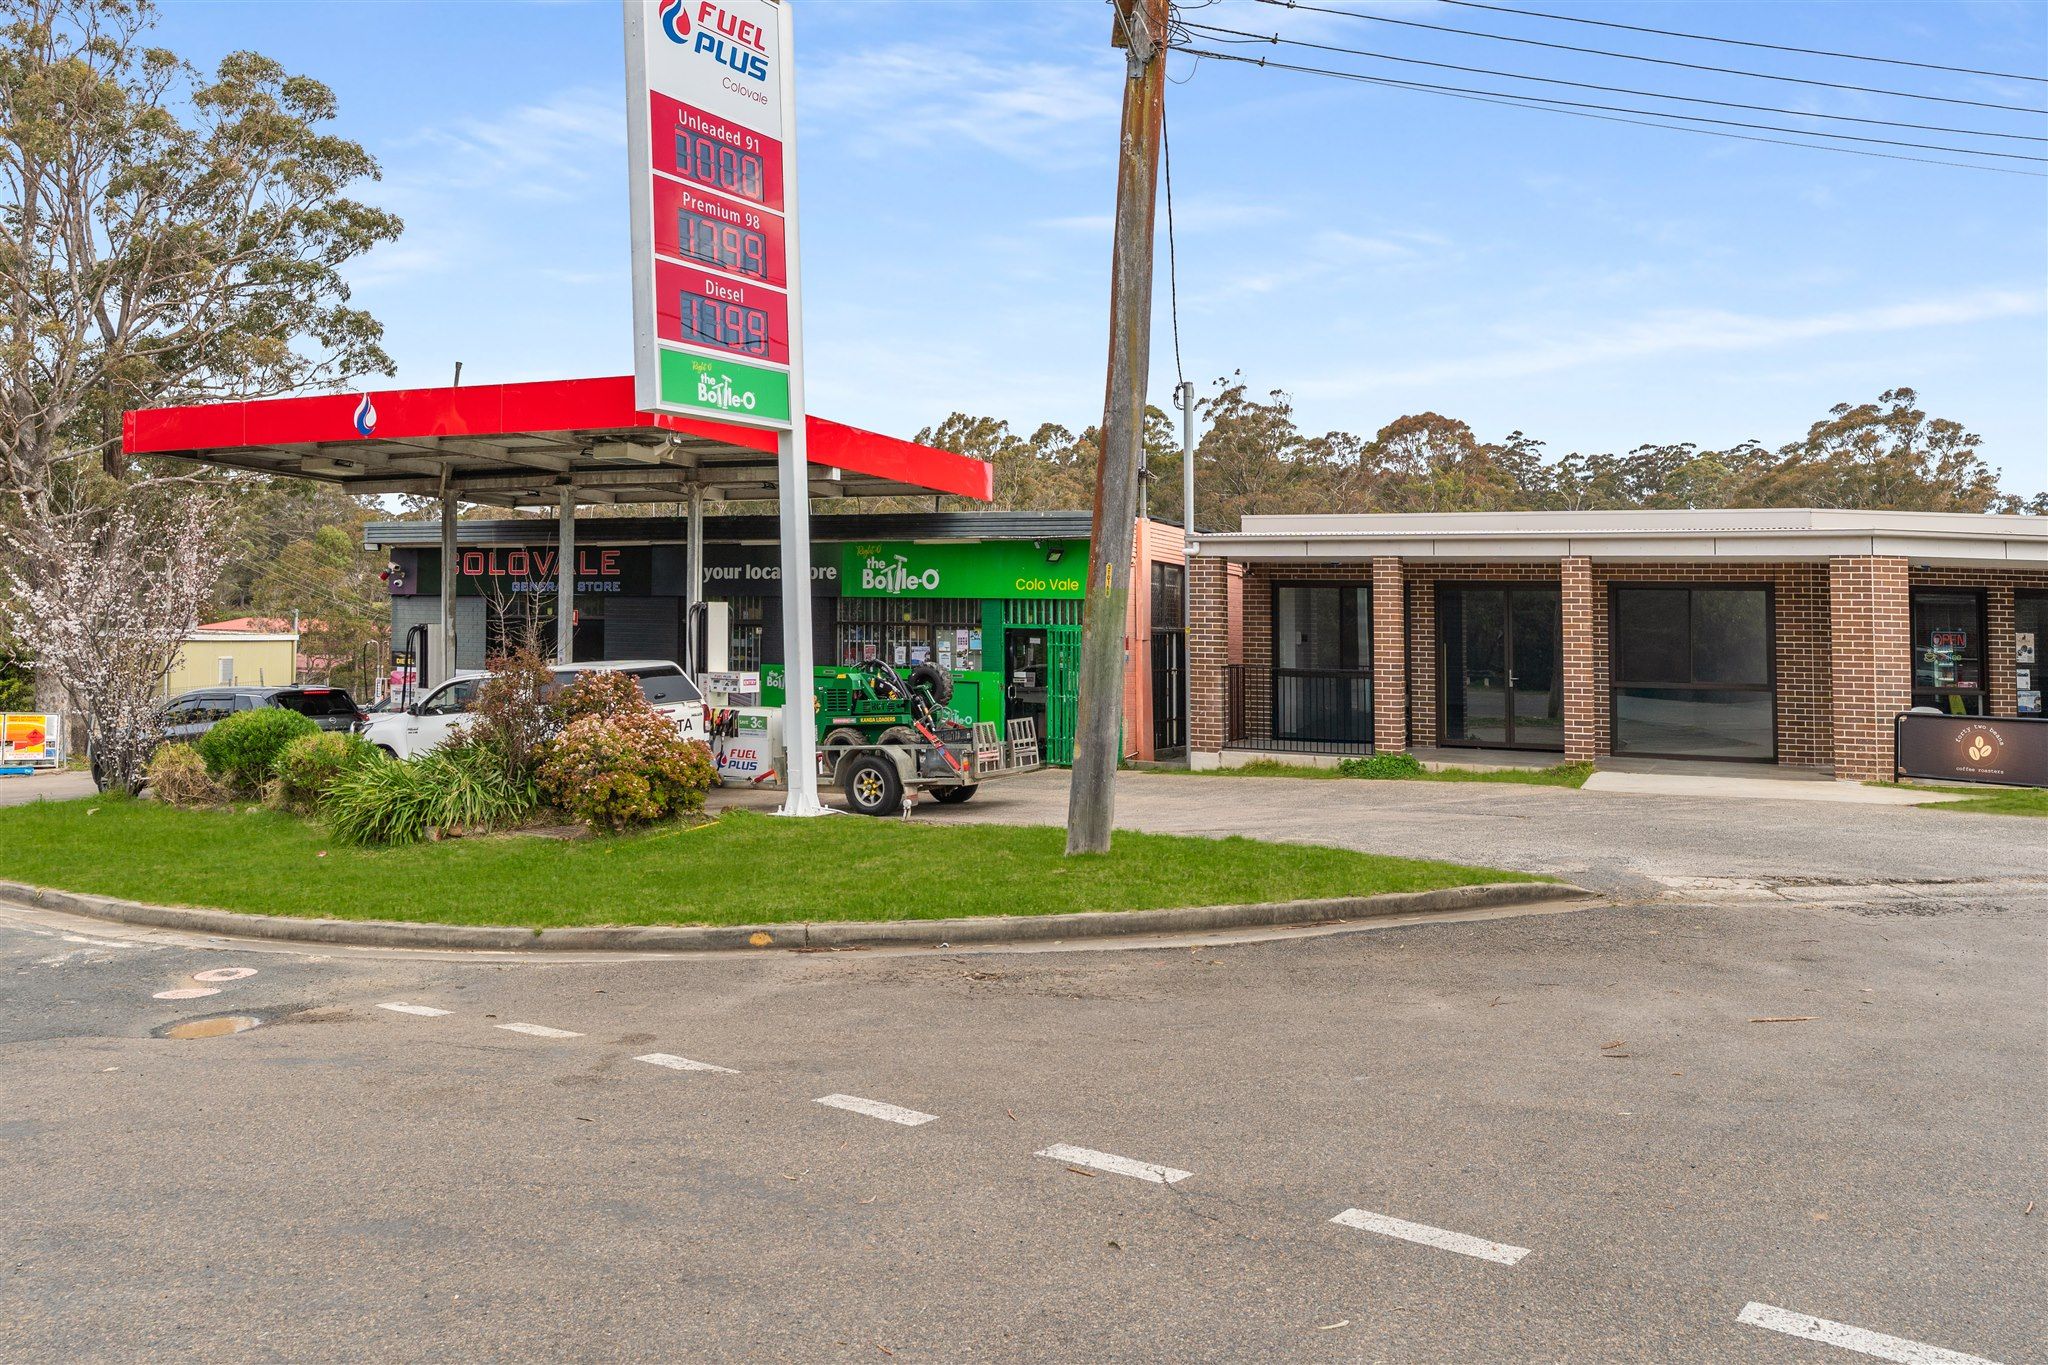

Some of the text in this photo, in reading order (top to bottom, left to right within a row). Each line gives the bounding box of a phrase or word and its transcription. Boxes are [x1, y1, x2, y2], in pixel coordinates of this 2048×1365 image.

[698, 1, 766, 52] FUEL
[694, 31, 769, 82] PLUS
[722, 77, 768, 106] Colovale
[678, 108, 760, 154] Unleaded 91
[683, 191, 760, 230] Premium 98
[705, 279, 744, 303] Diesel
[701, 372, 716, 385] the
[453, 550, 621, 576] OLOVLE
[866, 556, 886, 569] the
[703, 565, 742, 583] your
[746, 564, 781, 580] loca
[577, 581, 620, 591] STORE
[1015, 578, 1079, 591] Colo Vale
[1933, 633, 1965, 646] OPEN
[1989, 727, 2004, 746] beans
[730, 748, 757, 759] FUEL
[728, 760, 758, 771] PLUS
